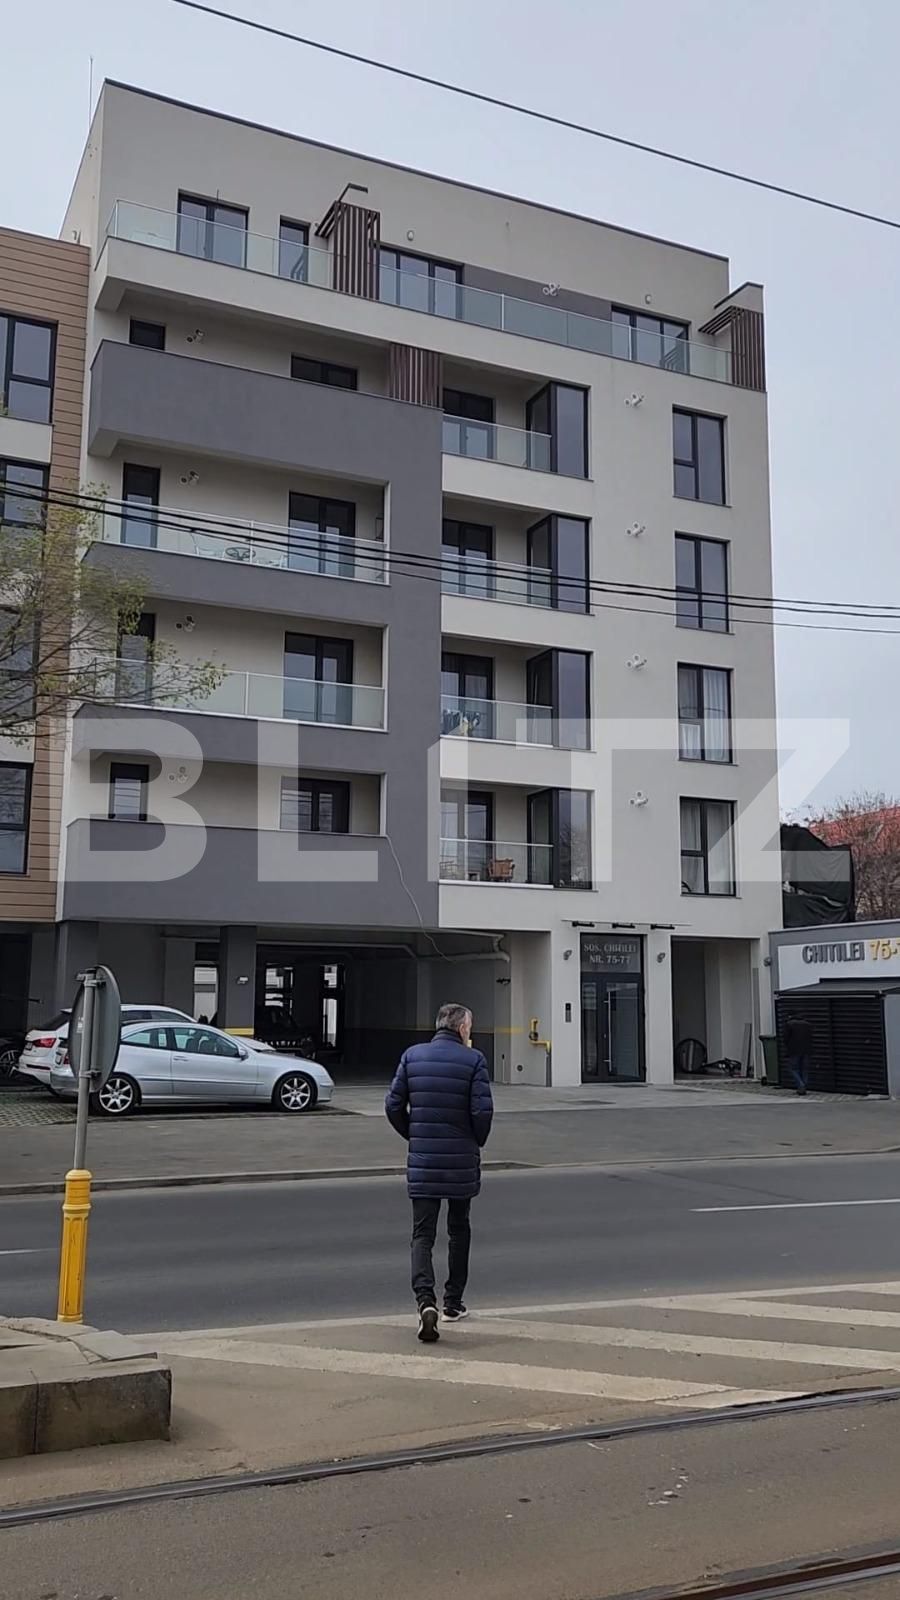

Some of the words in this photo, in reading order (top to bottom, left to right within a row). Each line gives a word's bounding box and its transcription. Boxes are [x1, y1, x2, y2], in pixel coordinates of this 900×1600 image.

[606, 955, 631, 964] 75-77
[802, 941, 865, 964] CHITILEI
[869, 939, 900, 961] 75-
